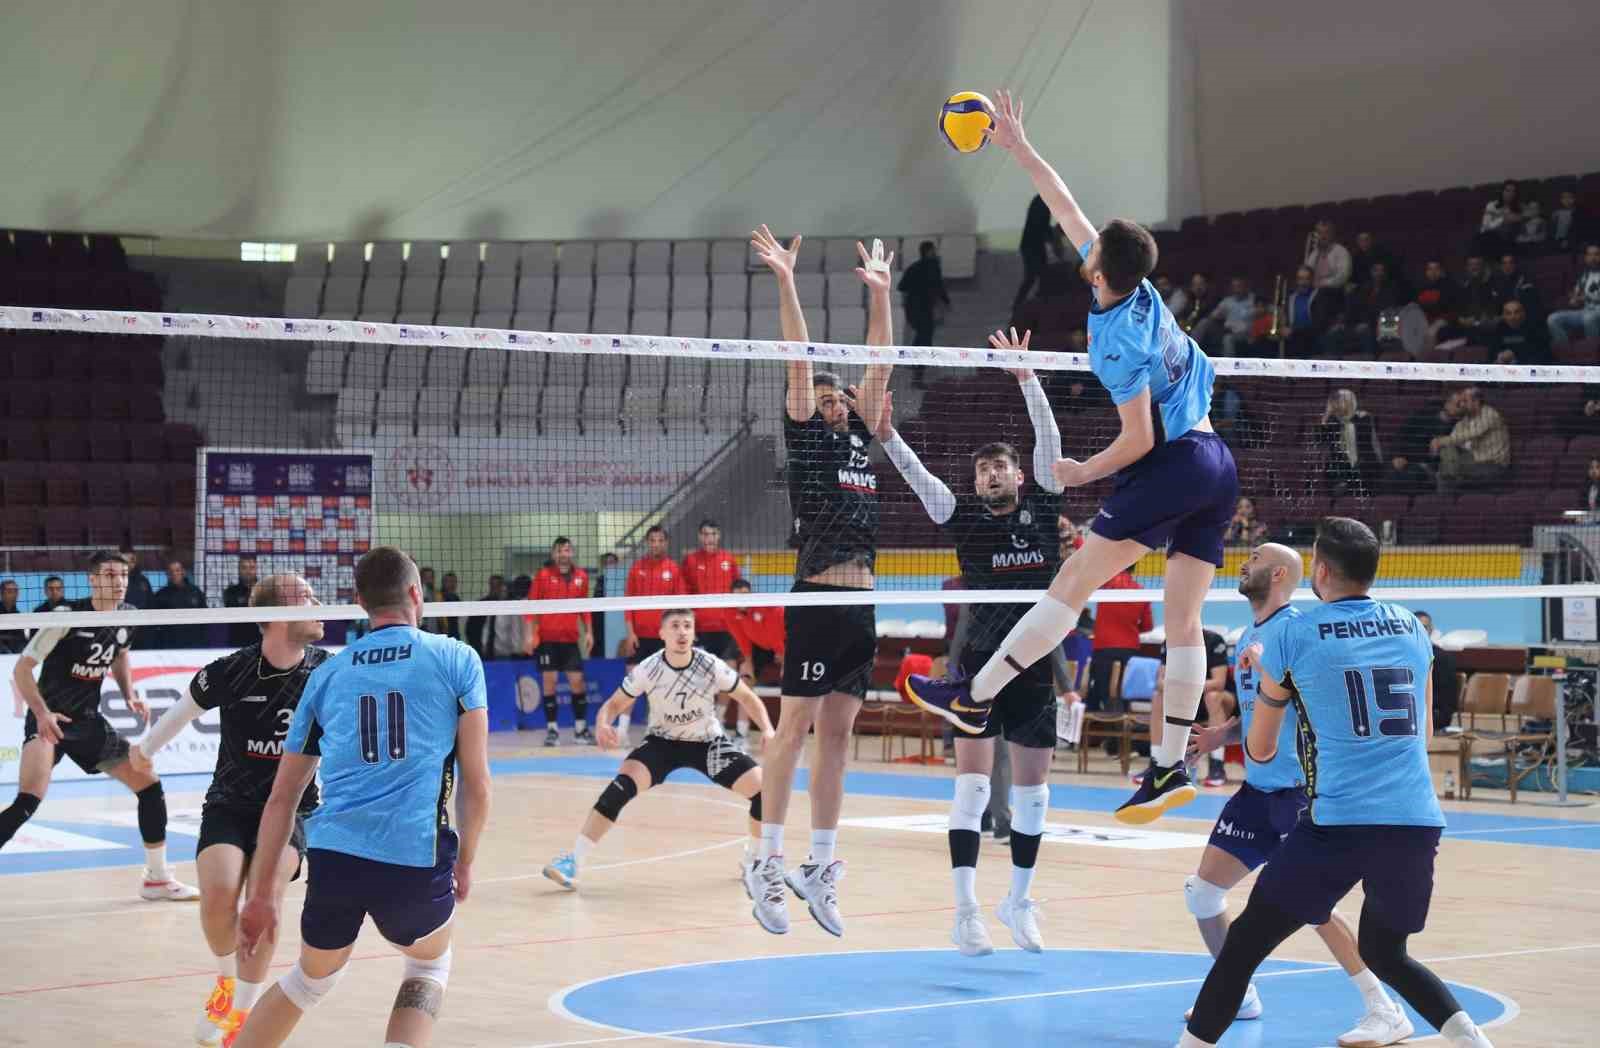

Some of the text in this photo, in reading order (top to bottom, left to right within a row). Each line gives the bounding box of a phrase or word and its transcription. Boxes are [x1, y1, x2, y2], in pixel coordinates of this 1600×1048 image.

[992, 549, 1044, 568] MANAS
[1318, 617, 1413, 640] PENCHEV
[86, 643, 115, 665] 24
[352, 644, 412, 666] KOOY
[800, 661, 826, 681] 19
[676, 691, 687, 709] 7
[1344, 666, 1418, 737] 15
[359, 690, 407, 764] 11
